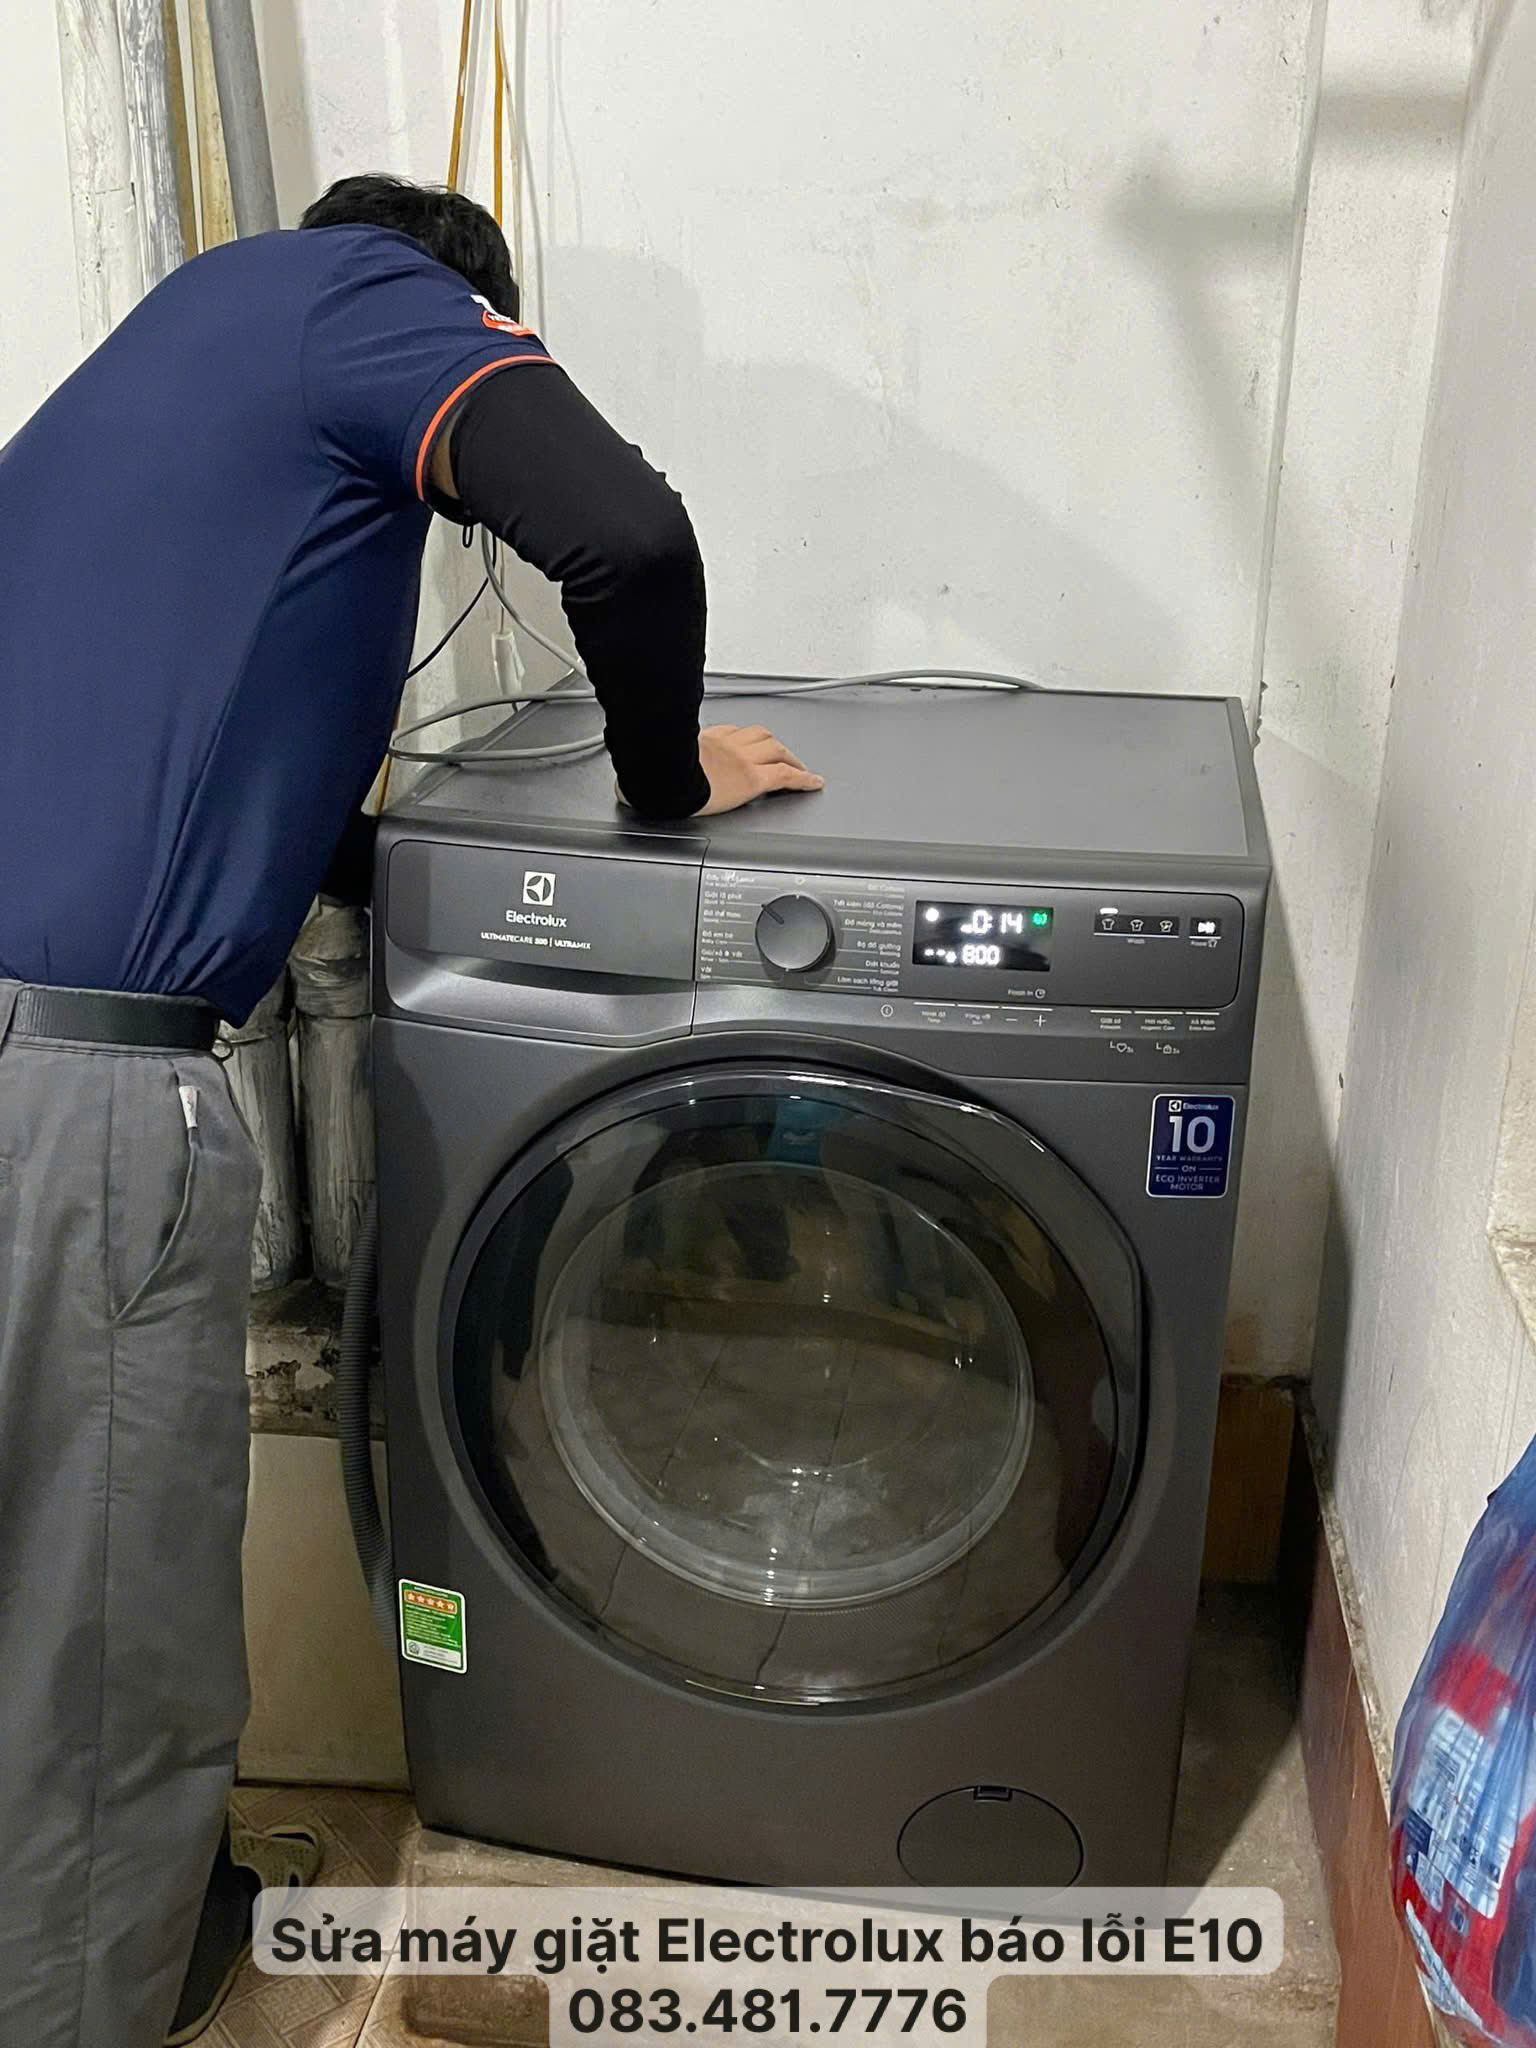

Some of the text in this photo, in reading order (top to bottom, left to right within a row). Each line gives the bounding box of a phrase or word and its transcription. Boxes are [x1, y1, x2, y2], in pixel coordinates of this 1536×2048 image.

[506, 909, 568, 928] Electrolux
[480, 931, 534, 945] ULTIMATECARE
[554, 939, 592, 950] ULTRAMIX
[962, 944, 1001, 966] 800
[1169, 1115, 1215, 1153] 10
[1155, 1174, 1220, 1184] ECO INVERTER
[1170, 1183, 1204, 1191] MOTOR
